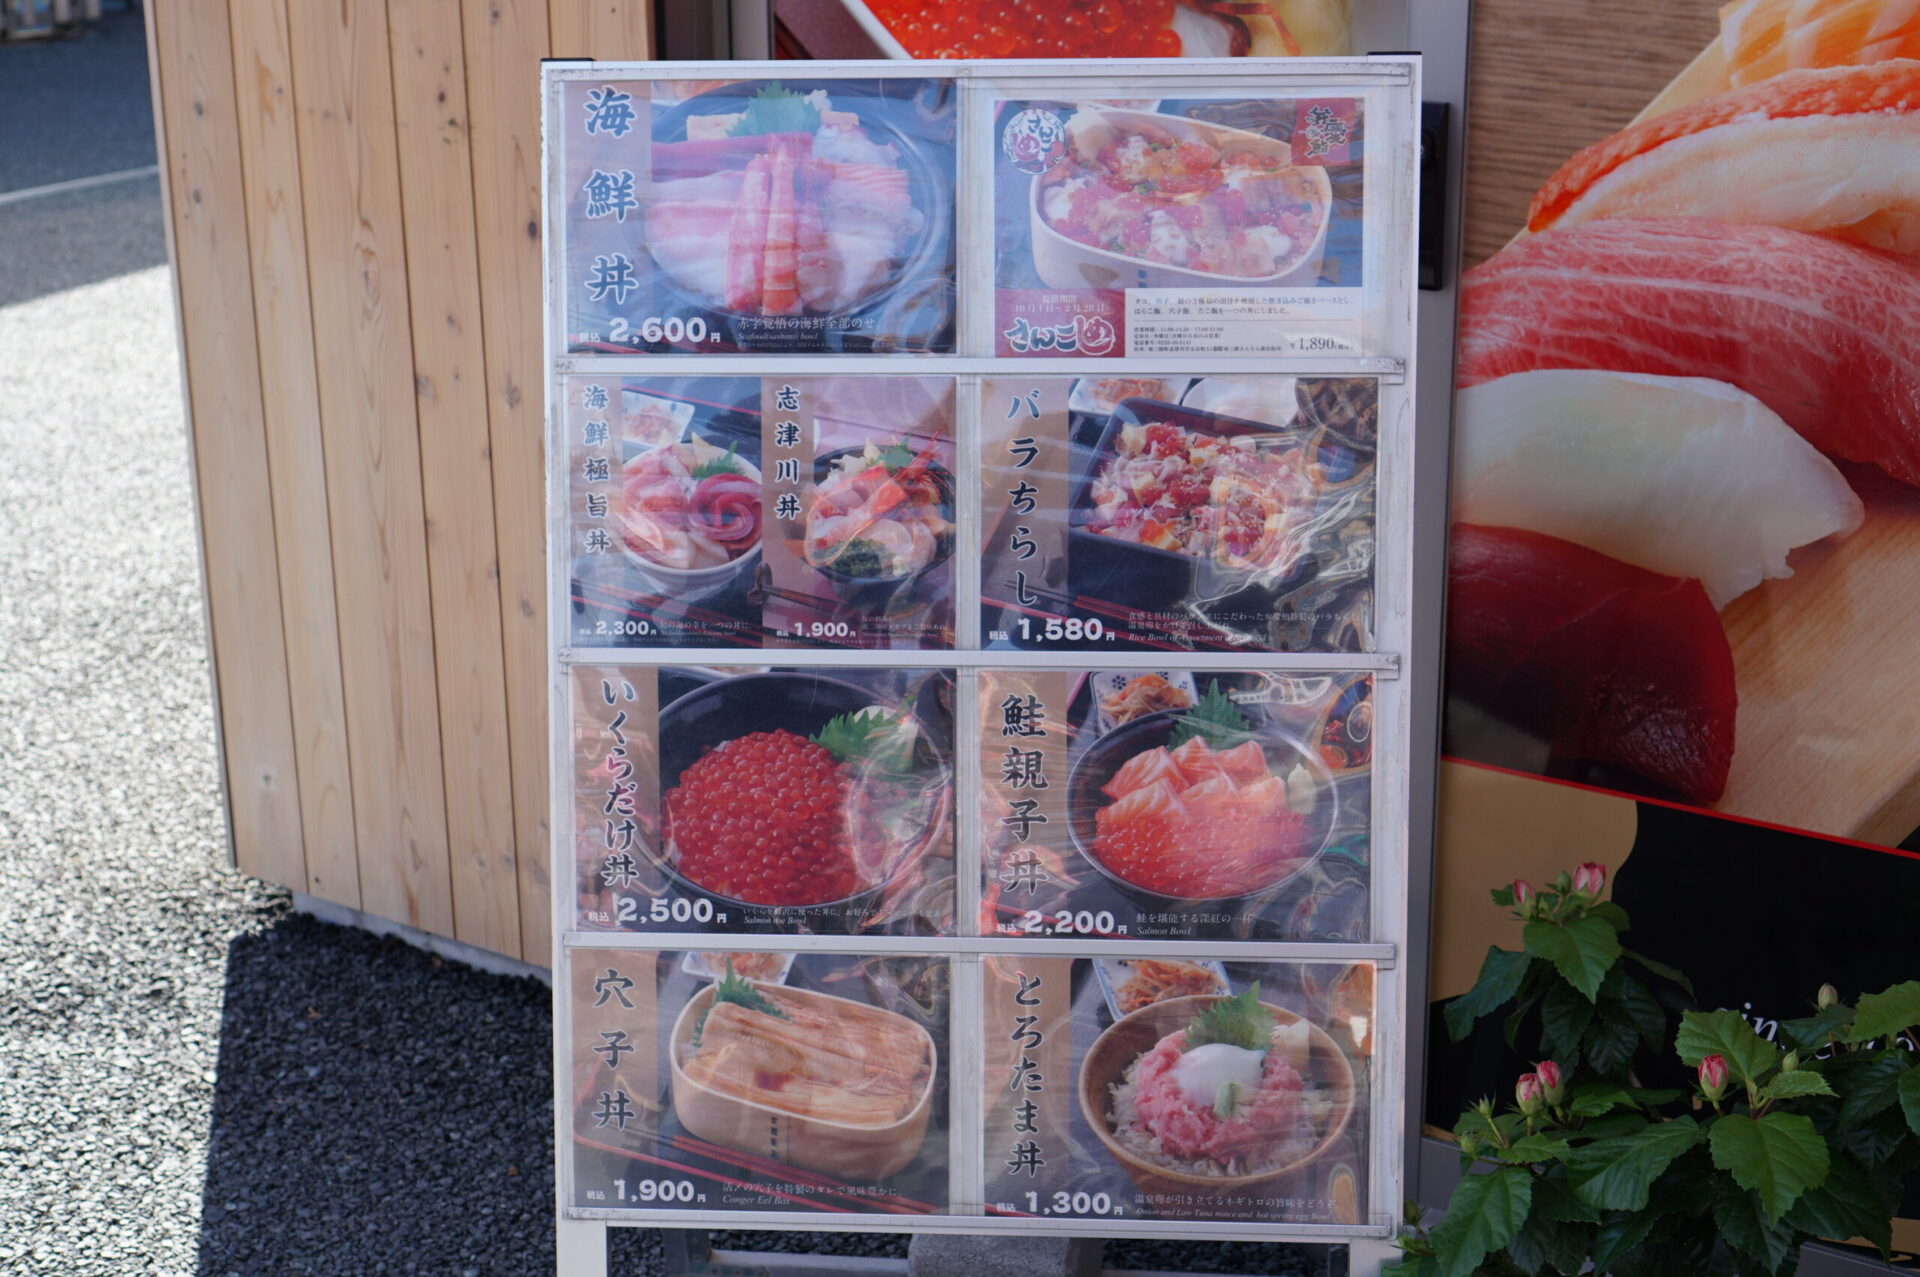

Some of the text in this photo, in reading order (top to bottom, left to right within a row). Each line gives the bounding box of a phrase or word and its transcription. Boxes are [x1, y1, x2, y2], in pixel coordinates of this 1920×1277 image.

[583, 85, 639, 305] 海鮮丼
[579, 332, 600, 343] 税込
[774, 385, 801, 520] 志津川丼
[583, 385, 612, 554] 海鮮極旨丼
[1007, 389, 1042, 607] バラちらし
[988, 630, 1009, 641] 税込
[1128, 632, 1145, 642] Rice
[1147, 632, 1168, 642] Bowl
[600, 678, 639, 888] いくらだけ丼
[999, 694, 1050, 896] 鮭親子丼
[588, 911, 609, 922] 税込
[743, 916, 771, 925] Salmon
[1136, 925, 1192, 936] Salmon Bowl
[593, 968, 636, 1132] 穴子丼
[1006, 971, 1047, 1177] とろたま丼
[586, 1190, 606, 1200] 税込
[722, 1195, 791, 1206] Conger Eel Box
[996, 1203, 1016, 1213] 税込
